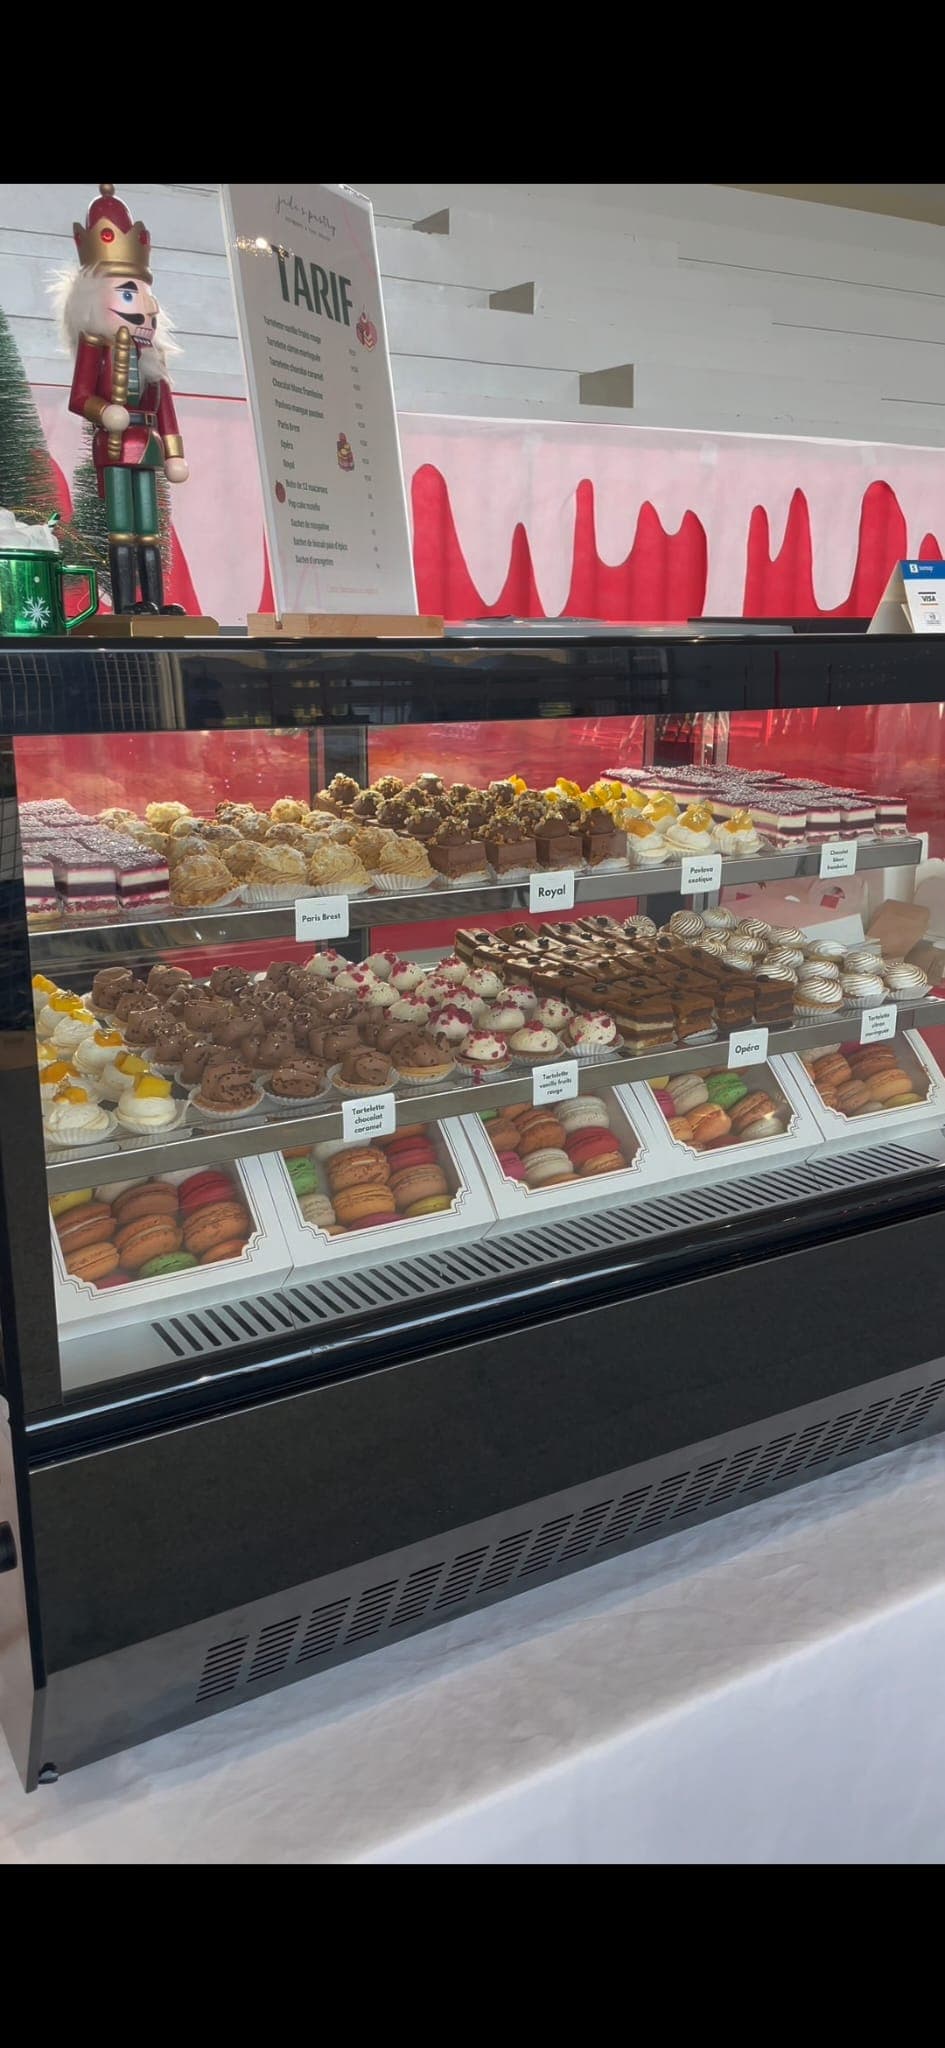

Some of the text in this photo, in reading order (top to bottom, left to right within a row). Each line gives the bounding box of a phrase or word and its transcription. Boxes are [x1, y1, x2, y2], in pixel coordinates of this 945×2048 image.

[271, 244, 353, 327] TARIF
[690, 866, 714, 874] Pavlova
[688, 876, 713, 884] exotique
[538, 883, 566, 899] Royal
[301, 912, 341, 923] Paris Brest
[735, 1043, 760, 1055] Opéra
[543, 1071, 569, 1080] Tartelette
[352, 1104, 385, 1115] Tartelette
[354, 1112, 383, 1124] chocolat
[354, 1121, 382, 1134] caramel
